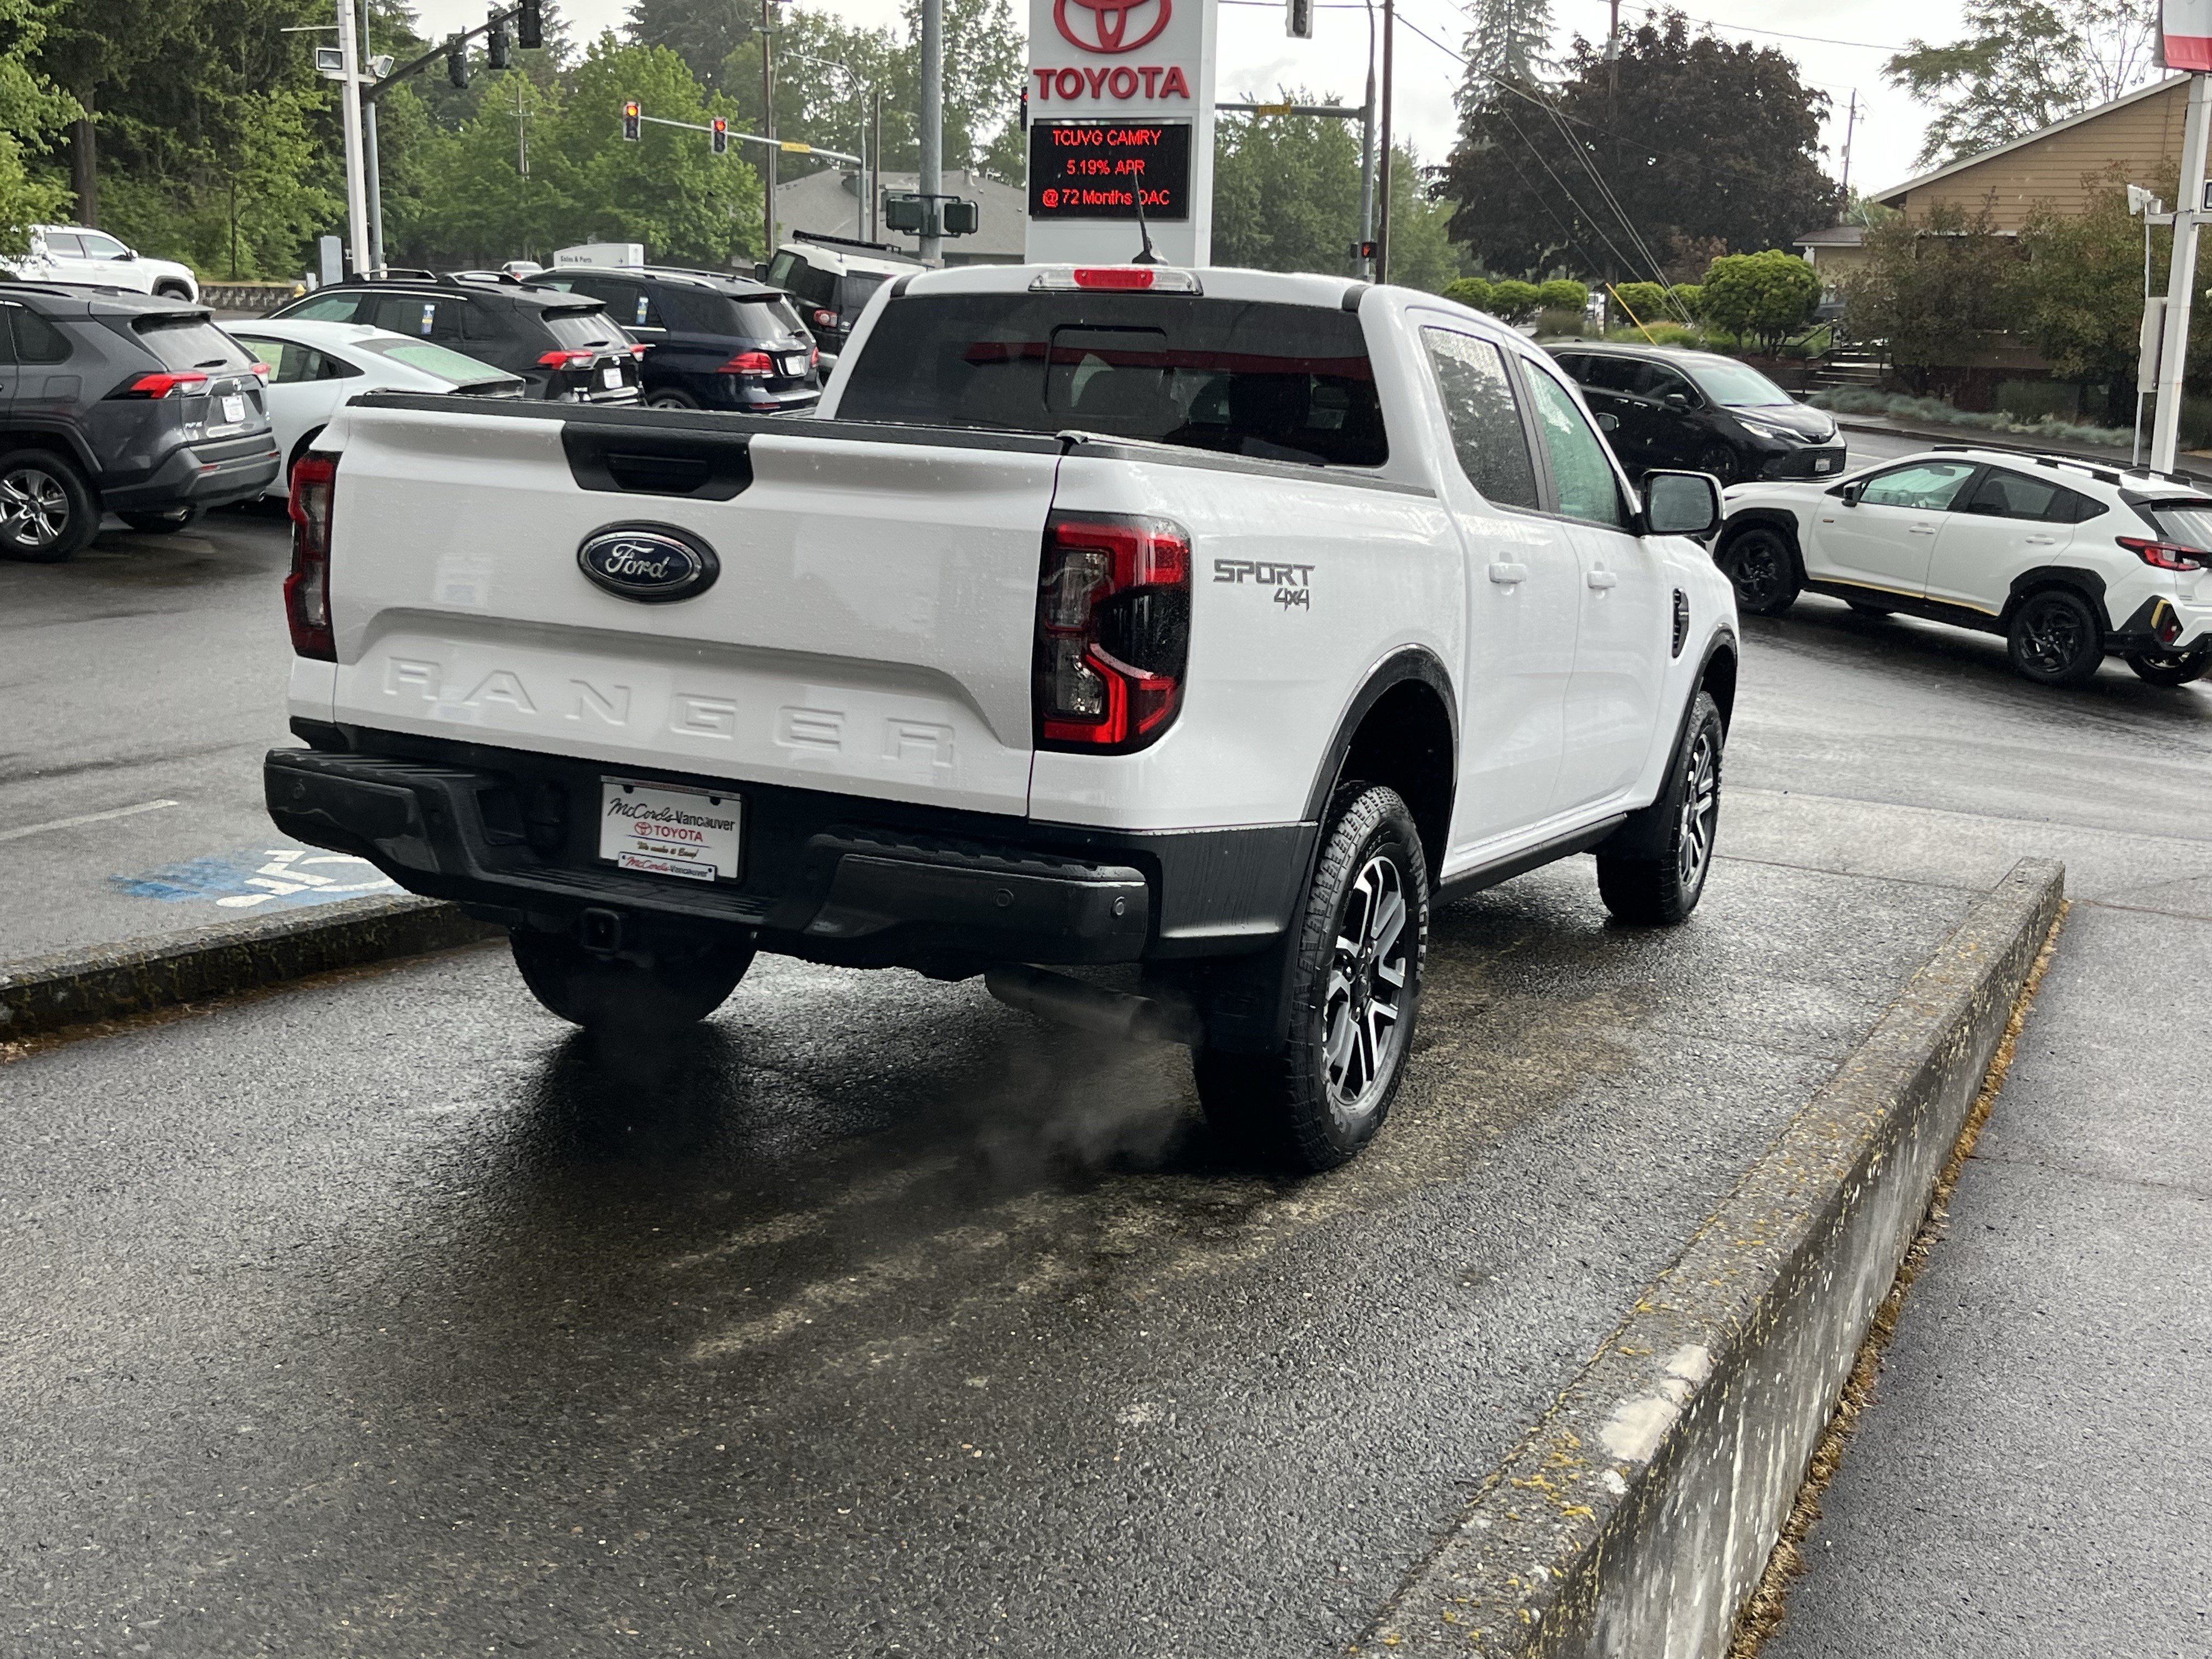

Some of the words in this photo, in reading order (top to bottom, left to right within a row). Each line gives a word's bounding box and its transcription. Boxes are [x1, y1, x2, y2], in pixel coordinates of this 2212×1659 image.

[1033, 66, 1190, 99] TOYOTA
[1052, 129, 1103, 146] TCUVG
[1107, 129, 1162, 146] CAMRY
[1115, 159, 1146, 176] APR
[1042, 189, 1059, 207] @
[1062, 189, 1080, 205] 72
[1083, 189, 1133, 205] Months
[605, 543, 671, 579] Ford
[1213, 558, 1316, 586] SPORT
[382, 657, 957, 768] RANGER
[675, 810, 736, 832] Vancouver
[654, 825, 703, 842] TOYOTA
